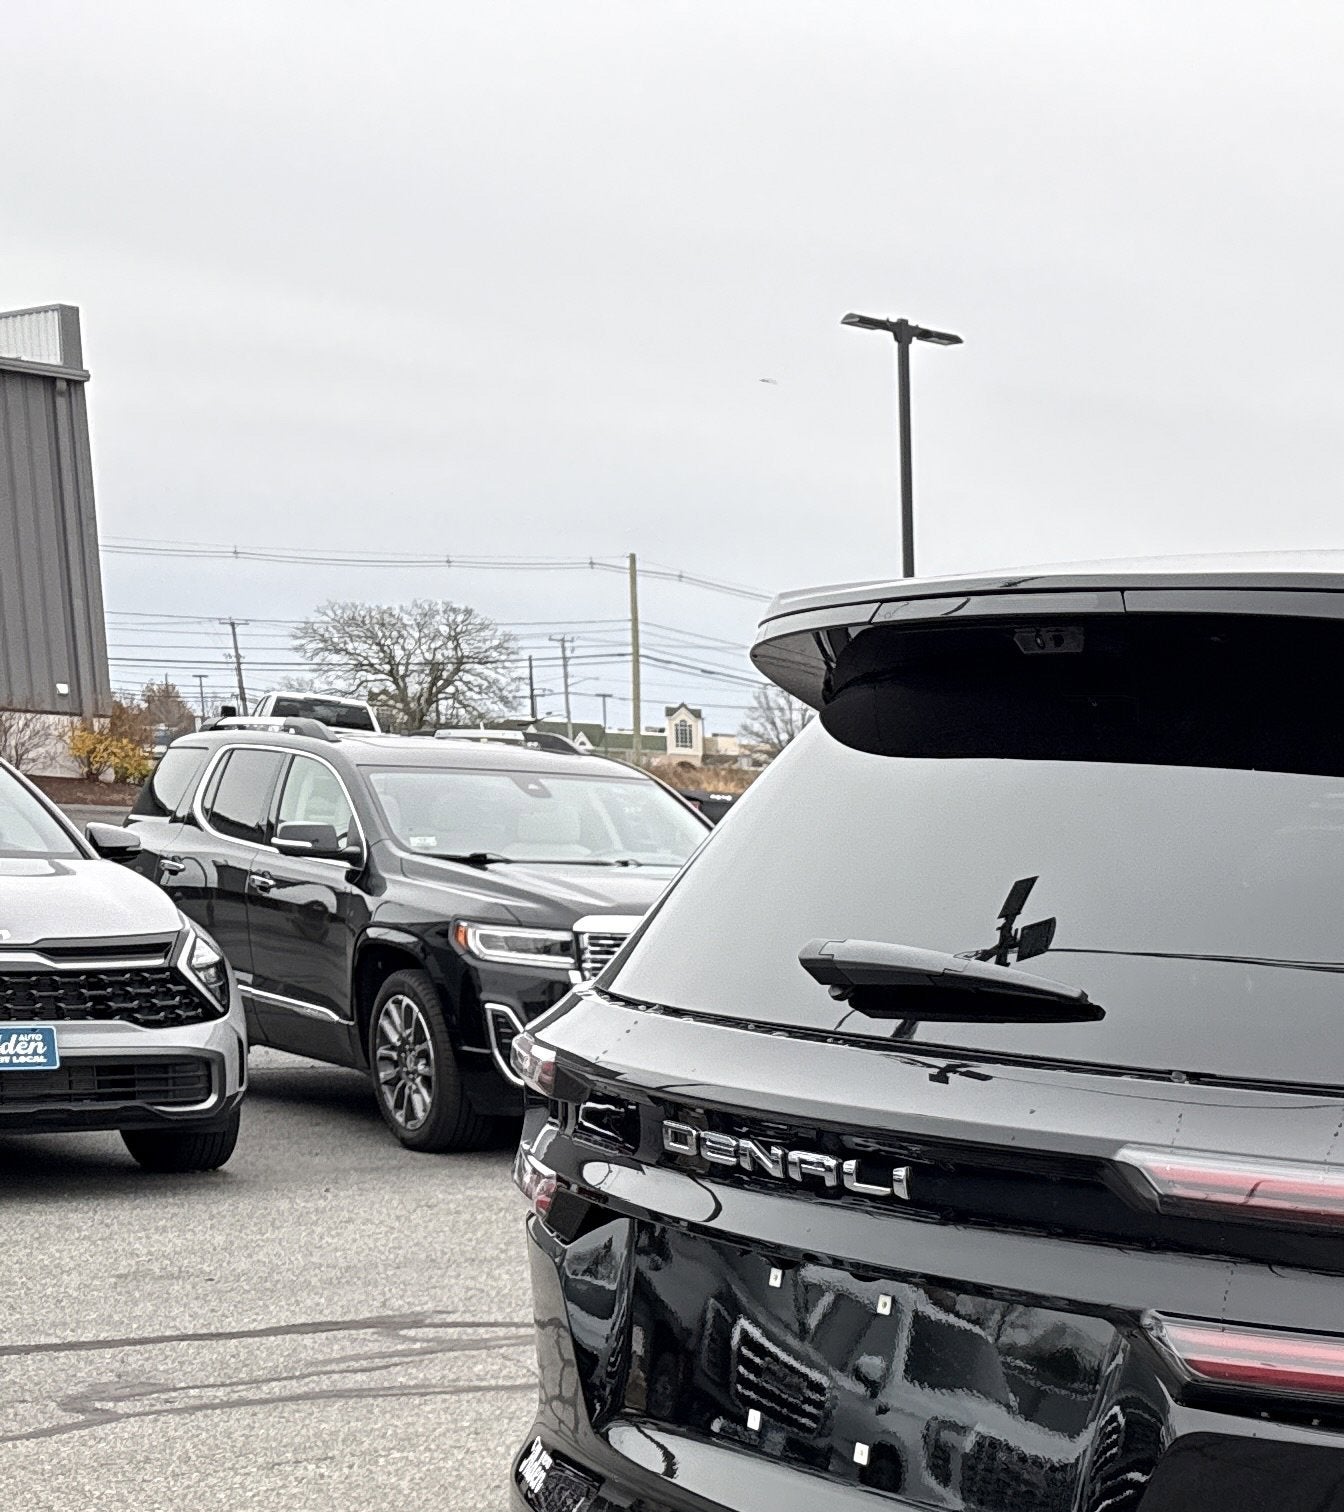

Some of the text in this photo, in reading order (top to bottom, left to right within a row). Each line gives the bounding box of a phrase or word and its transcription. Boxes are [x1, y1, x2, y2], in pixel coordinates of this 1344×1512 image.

[0, 1033, 47, 1055] den
[18, 1033, 42, 1041] AUTO
[662, 1119, 913, 1200] DENALI
